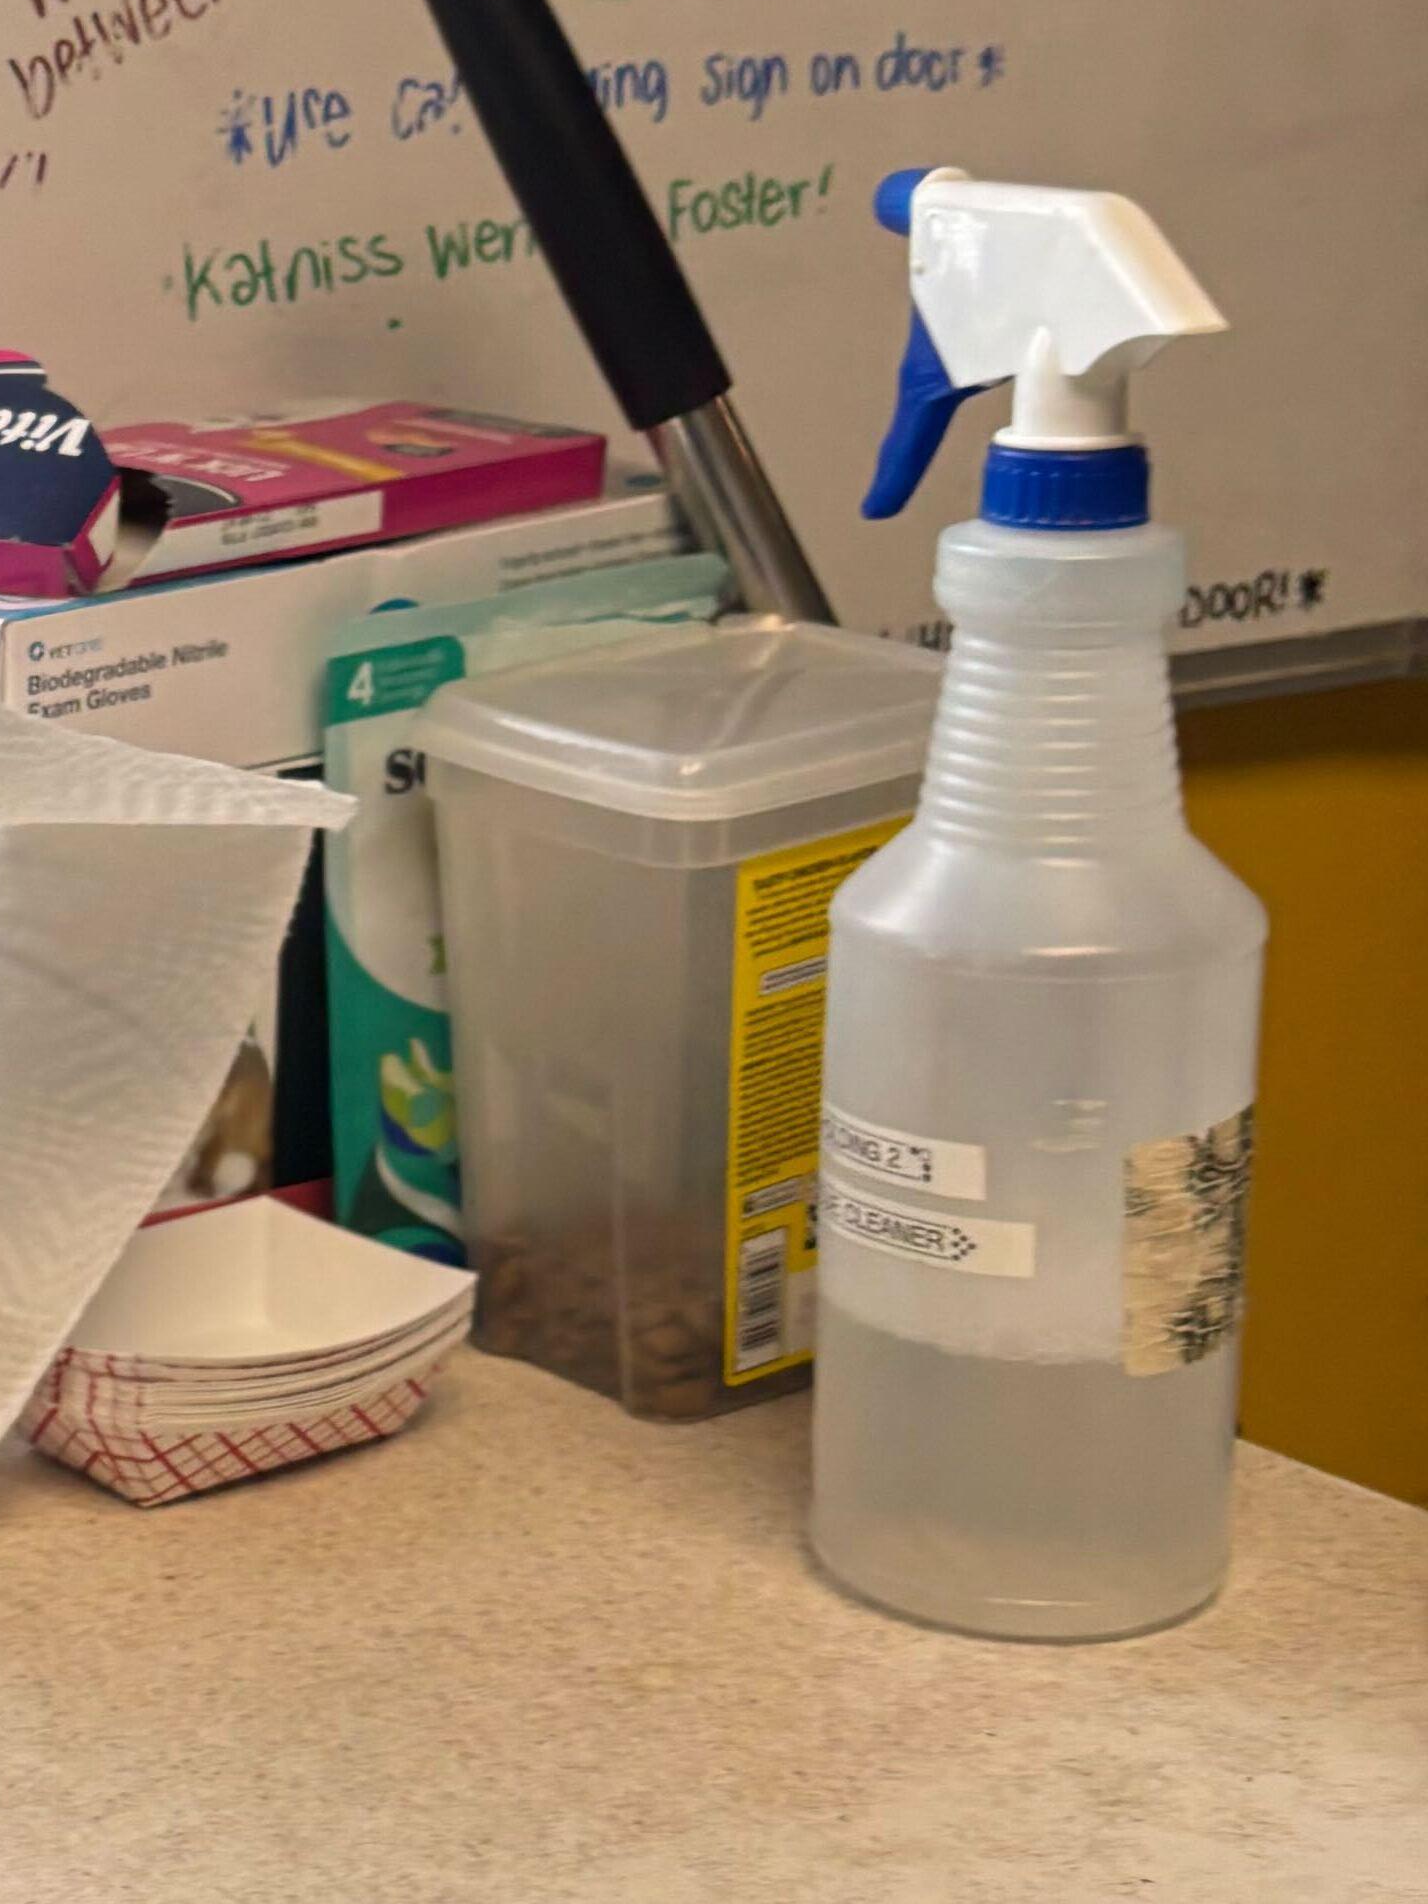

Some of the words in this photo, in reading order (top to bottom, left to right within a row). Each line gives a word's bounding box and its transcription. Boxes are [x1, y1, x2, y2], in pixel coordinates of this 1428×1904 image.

[809, 52, 861, 95] on
[184, 234, 405, 323] Katniss
[668, 162, 835, 243] Foster!
[27, 652, 167, 695] Biodegradable
[172, 639, 229, 666] Nitrile
[347, 661, 375, 708] 4
[87, 683, 152, 711] Gloves
[886, 1146, 903, 1170] 2
[845, 1202, 946, 1253] CLEANER
